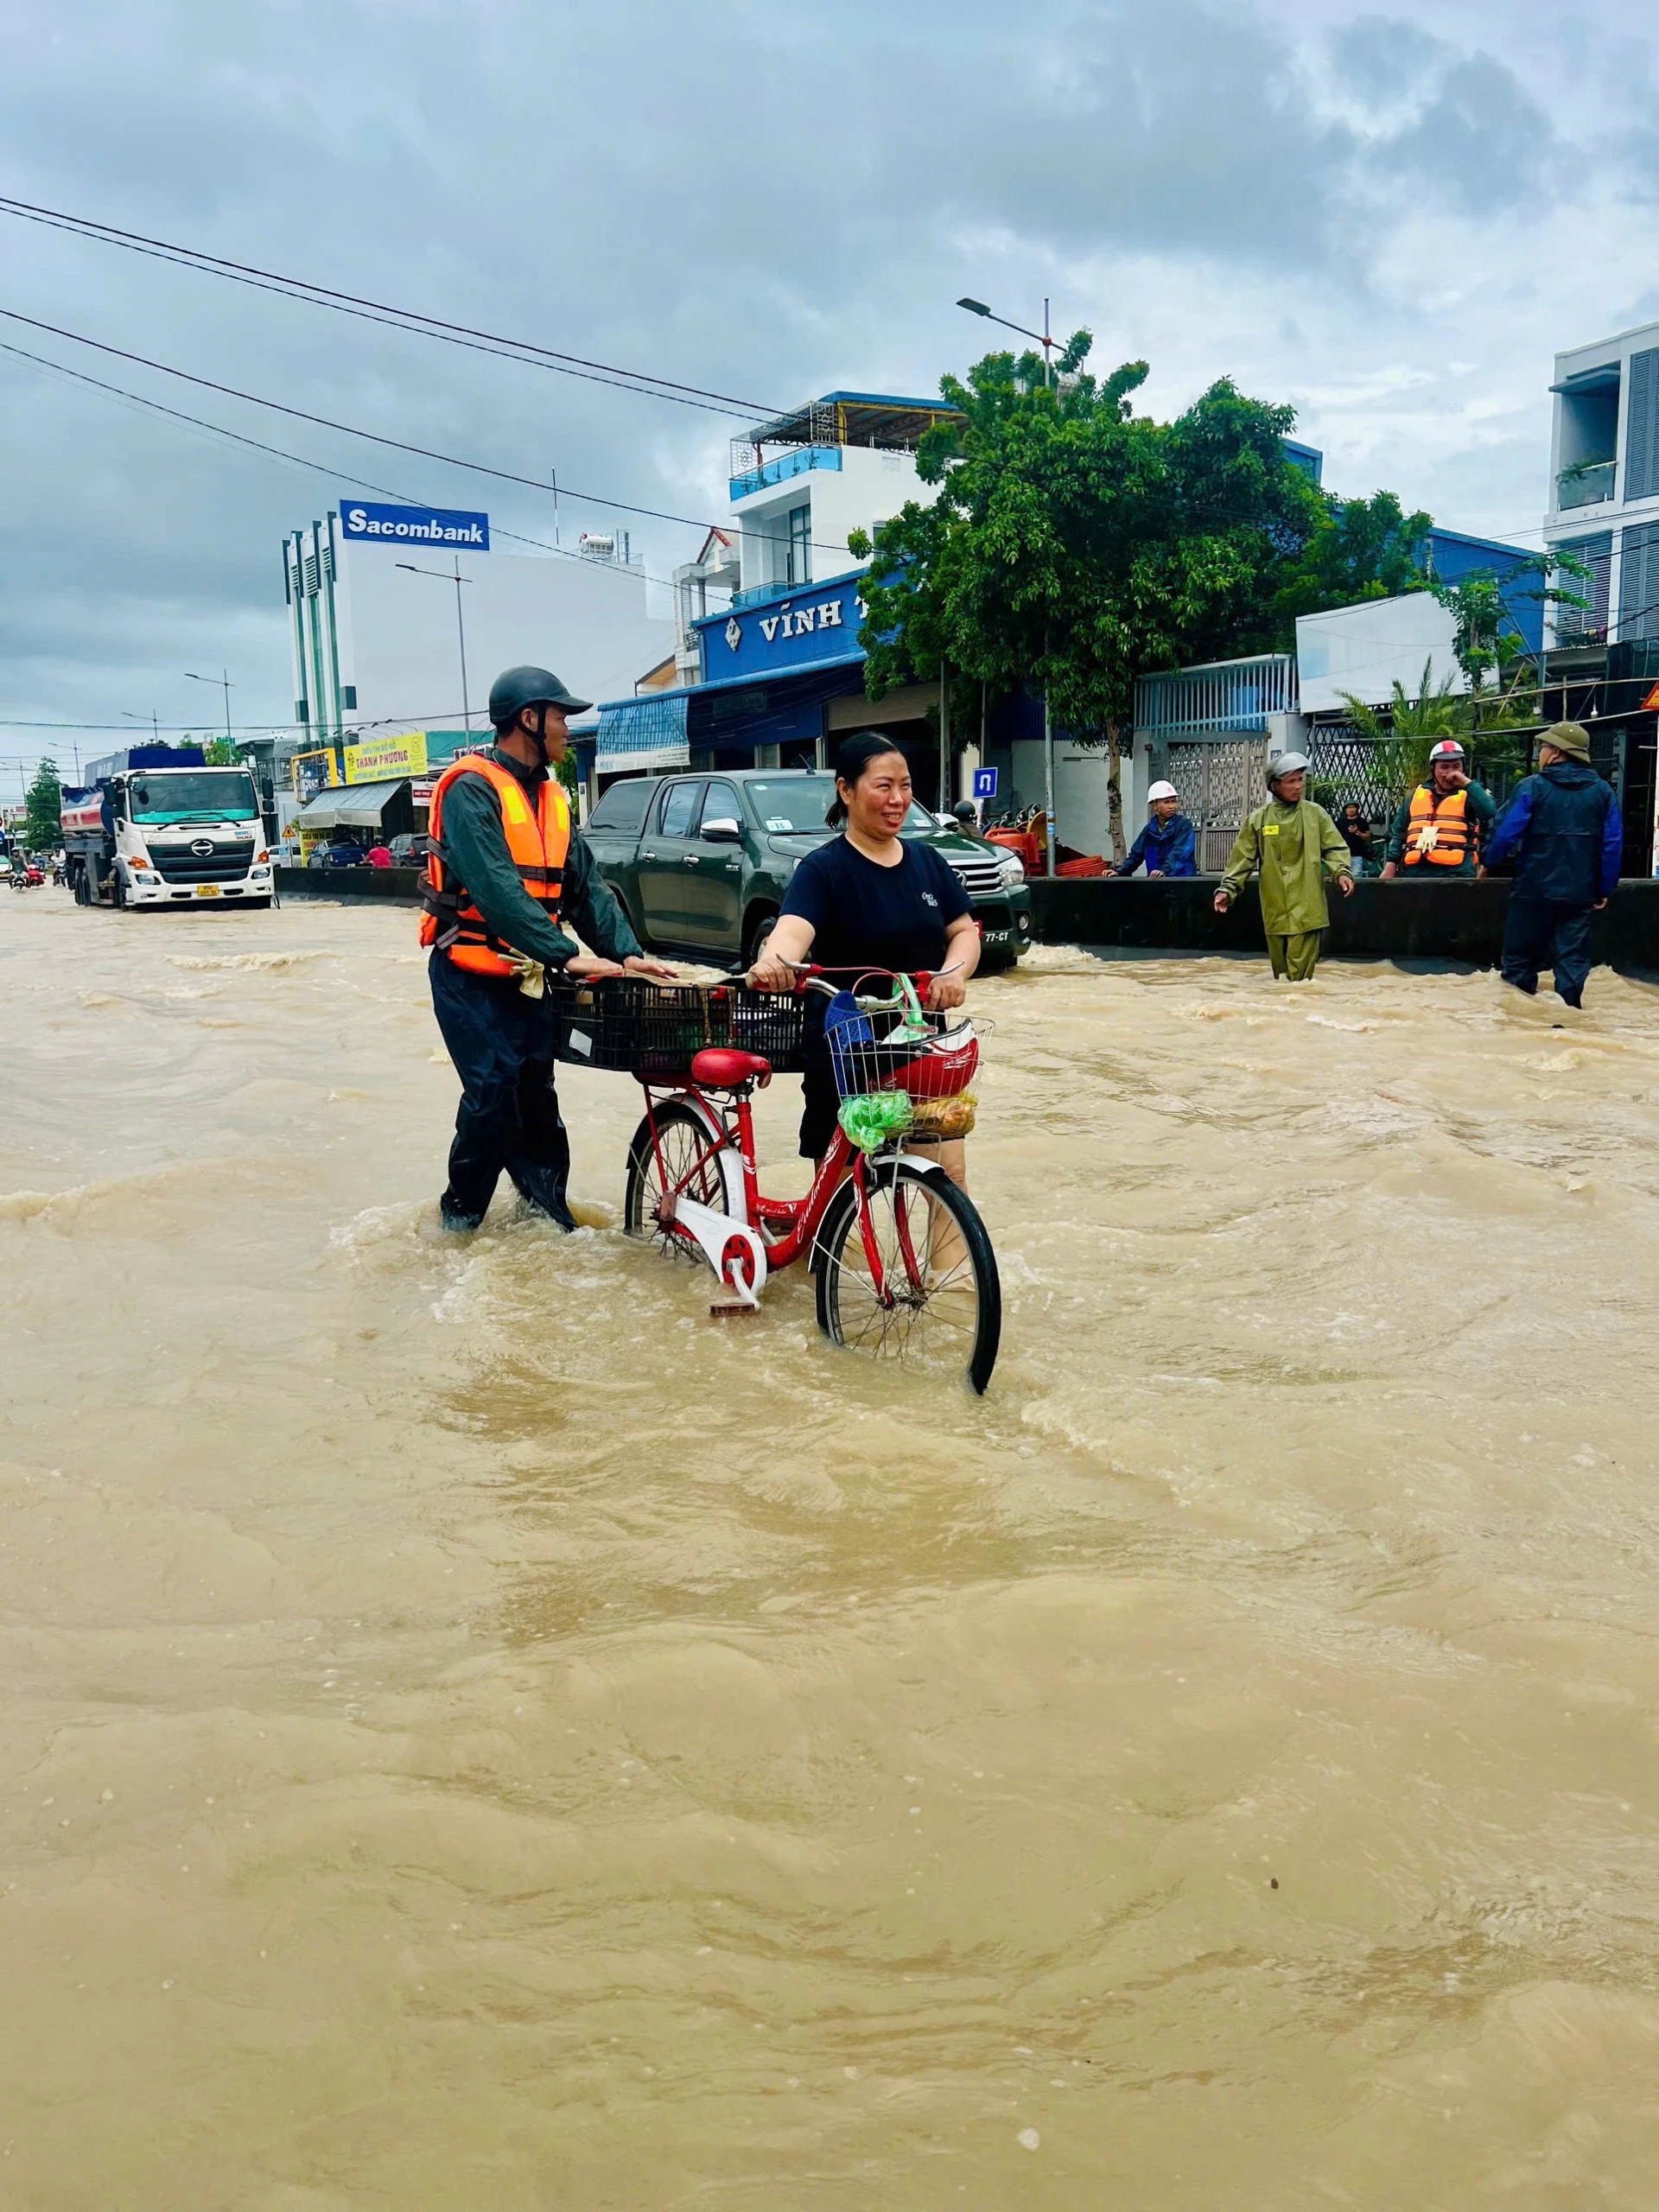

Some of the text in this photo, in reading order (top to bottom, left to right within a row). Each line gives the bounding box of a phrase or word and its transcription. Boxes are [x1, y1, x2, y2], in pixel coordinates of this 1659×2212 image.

[347, 508, 484, 543] Sacombank
[759, 601, 842, 642] VĨNH
[356, 755, 378, 769] THANH
[985, 932, 1009, 943] 77-CT
